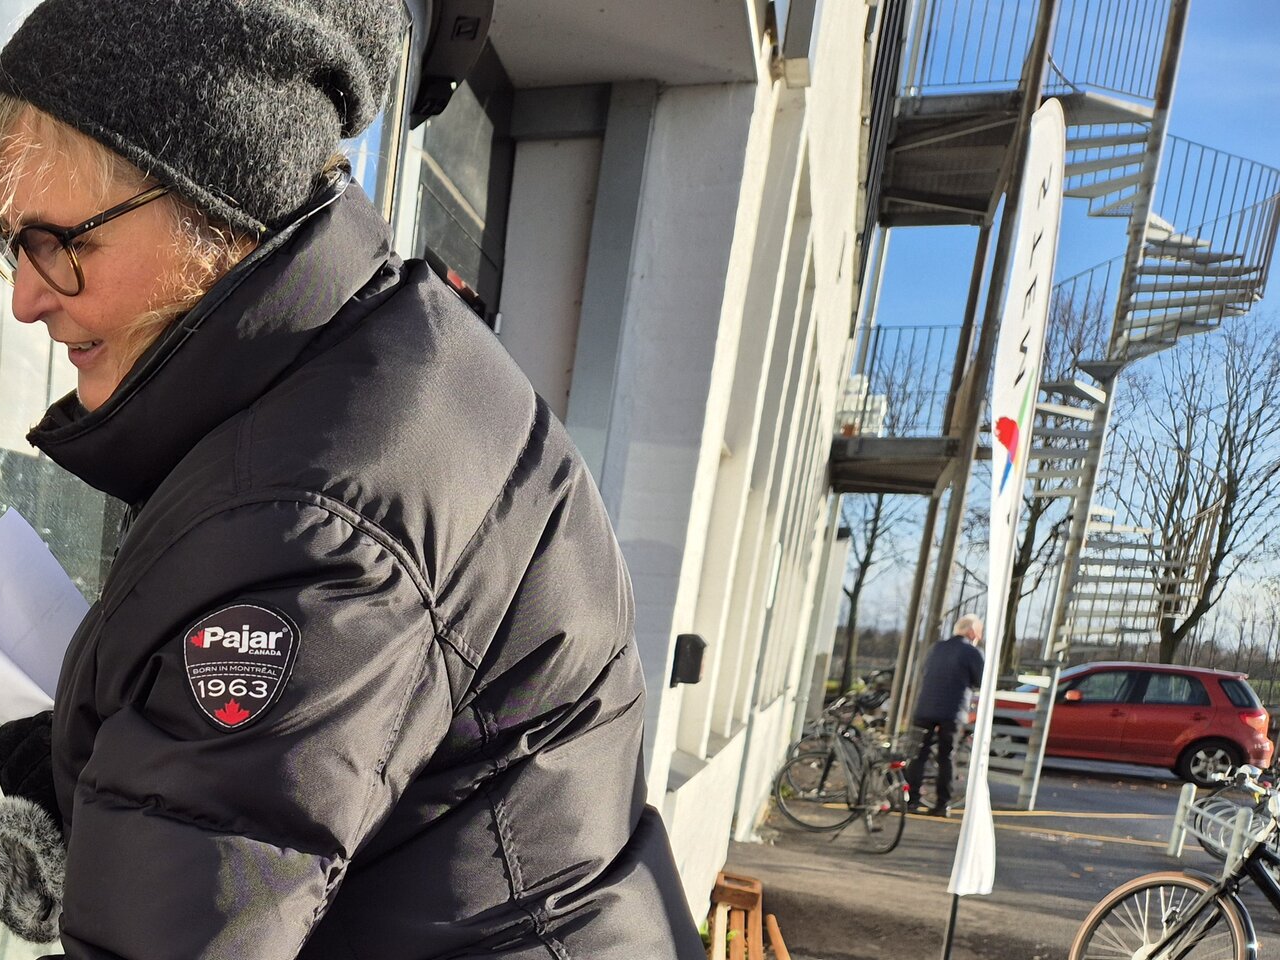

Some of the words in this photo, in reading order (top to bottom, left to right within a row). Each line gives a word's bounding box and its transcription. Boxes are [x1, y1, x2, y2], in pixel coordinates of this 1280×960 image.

[203, 625, 283, 653] Pajar
[249, 648, 282, 656] CANADA
[193, 667, 217, 675] BORN
[229, 665, 277, 676] MONTRÉAL
[197, 679, 268, 698] 1963
